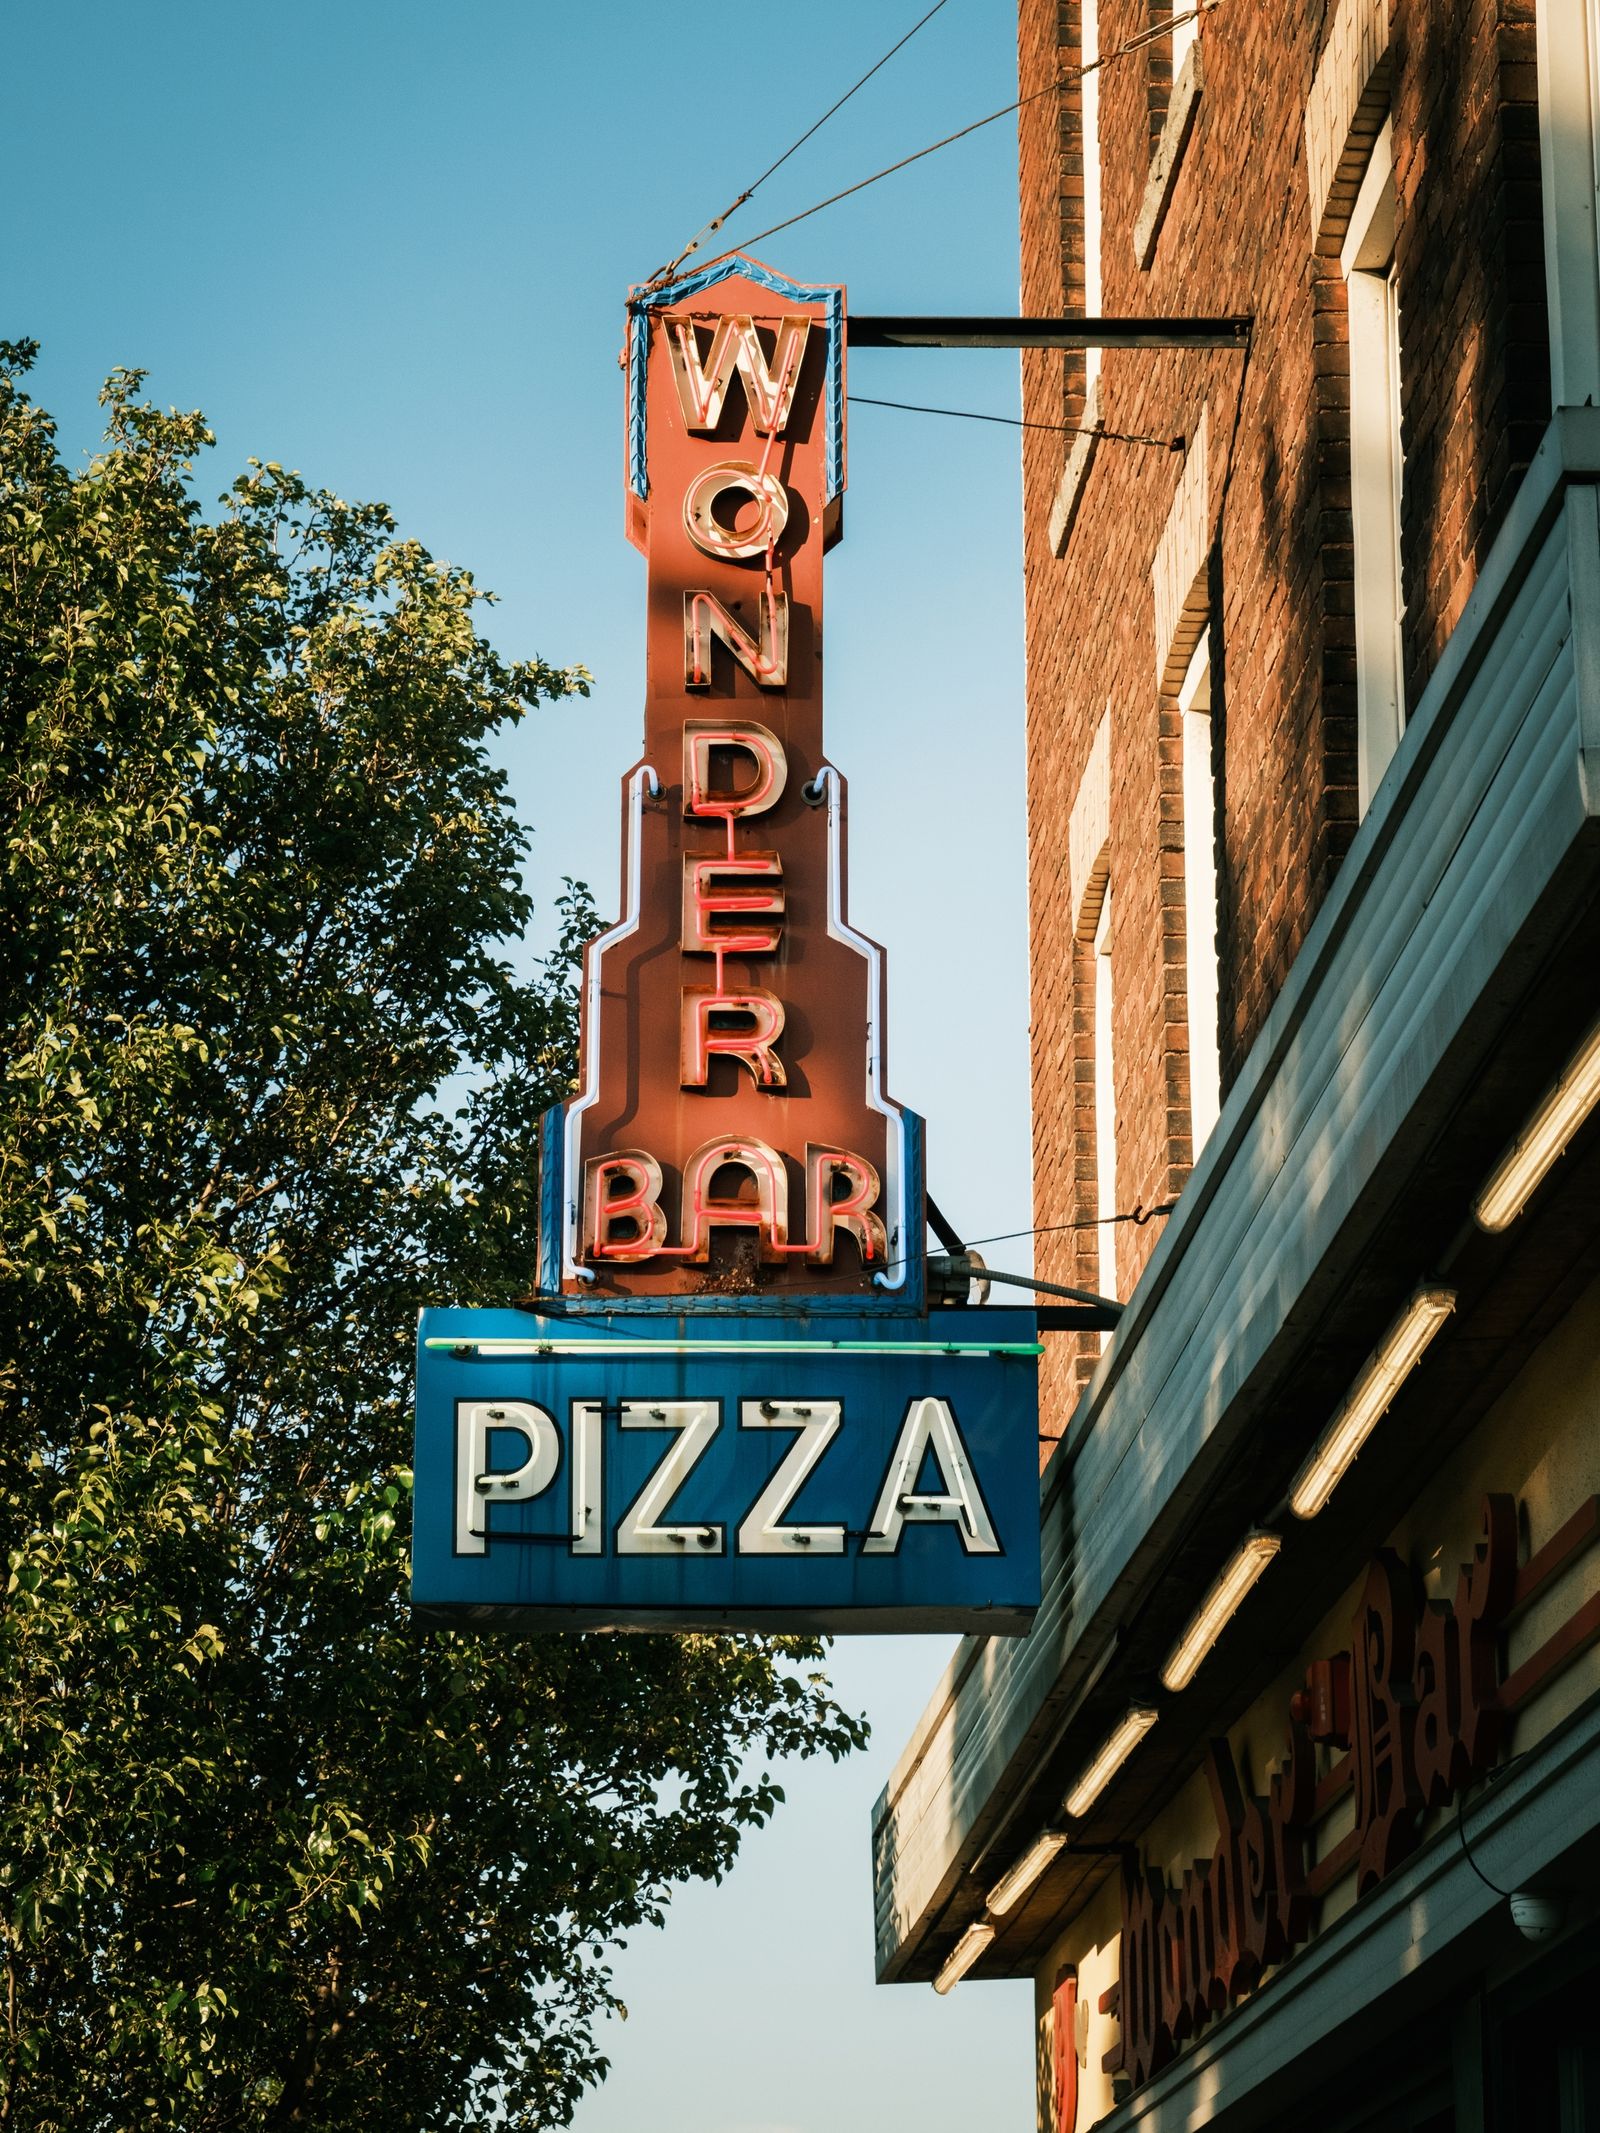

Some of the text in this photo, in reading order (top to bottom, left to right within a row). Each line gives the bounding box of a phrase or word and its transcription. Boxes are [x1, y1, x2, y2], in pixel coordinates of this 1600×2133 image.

[662, 315, 812, 1089] WONDER
[584, 1134, 887, 1266] BAR
[453, 1397, 1003, 1557] PIZZA
[1353, 1493, 1514, 1900] Bar
